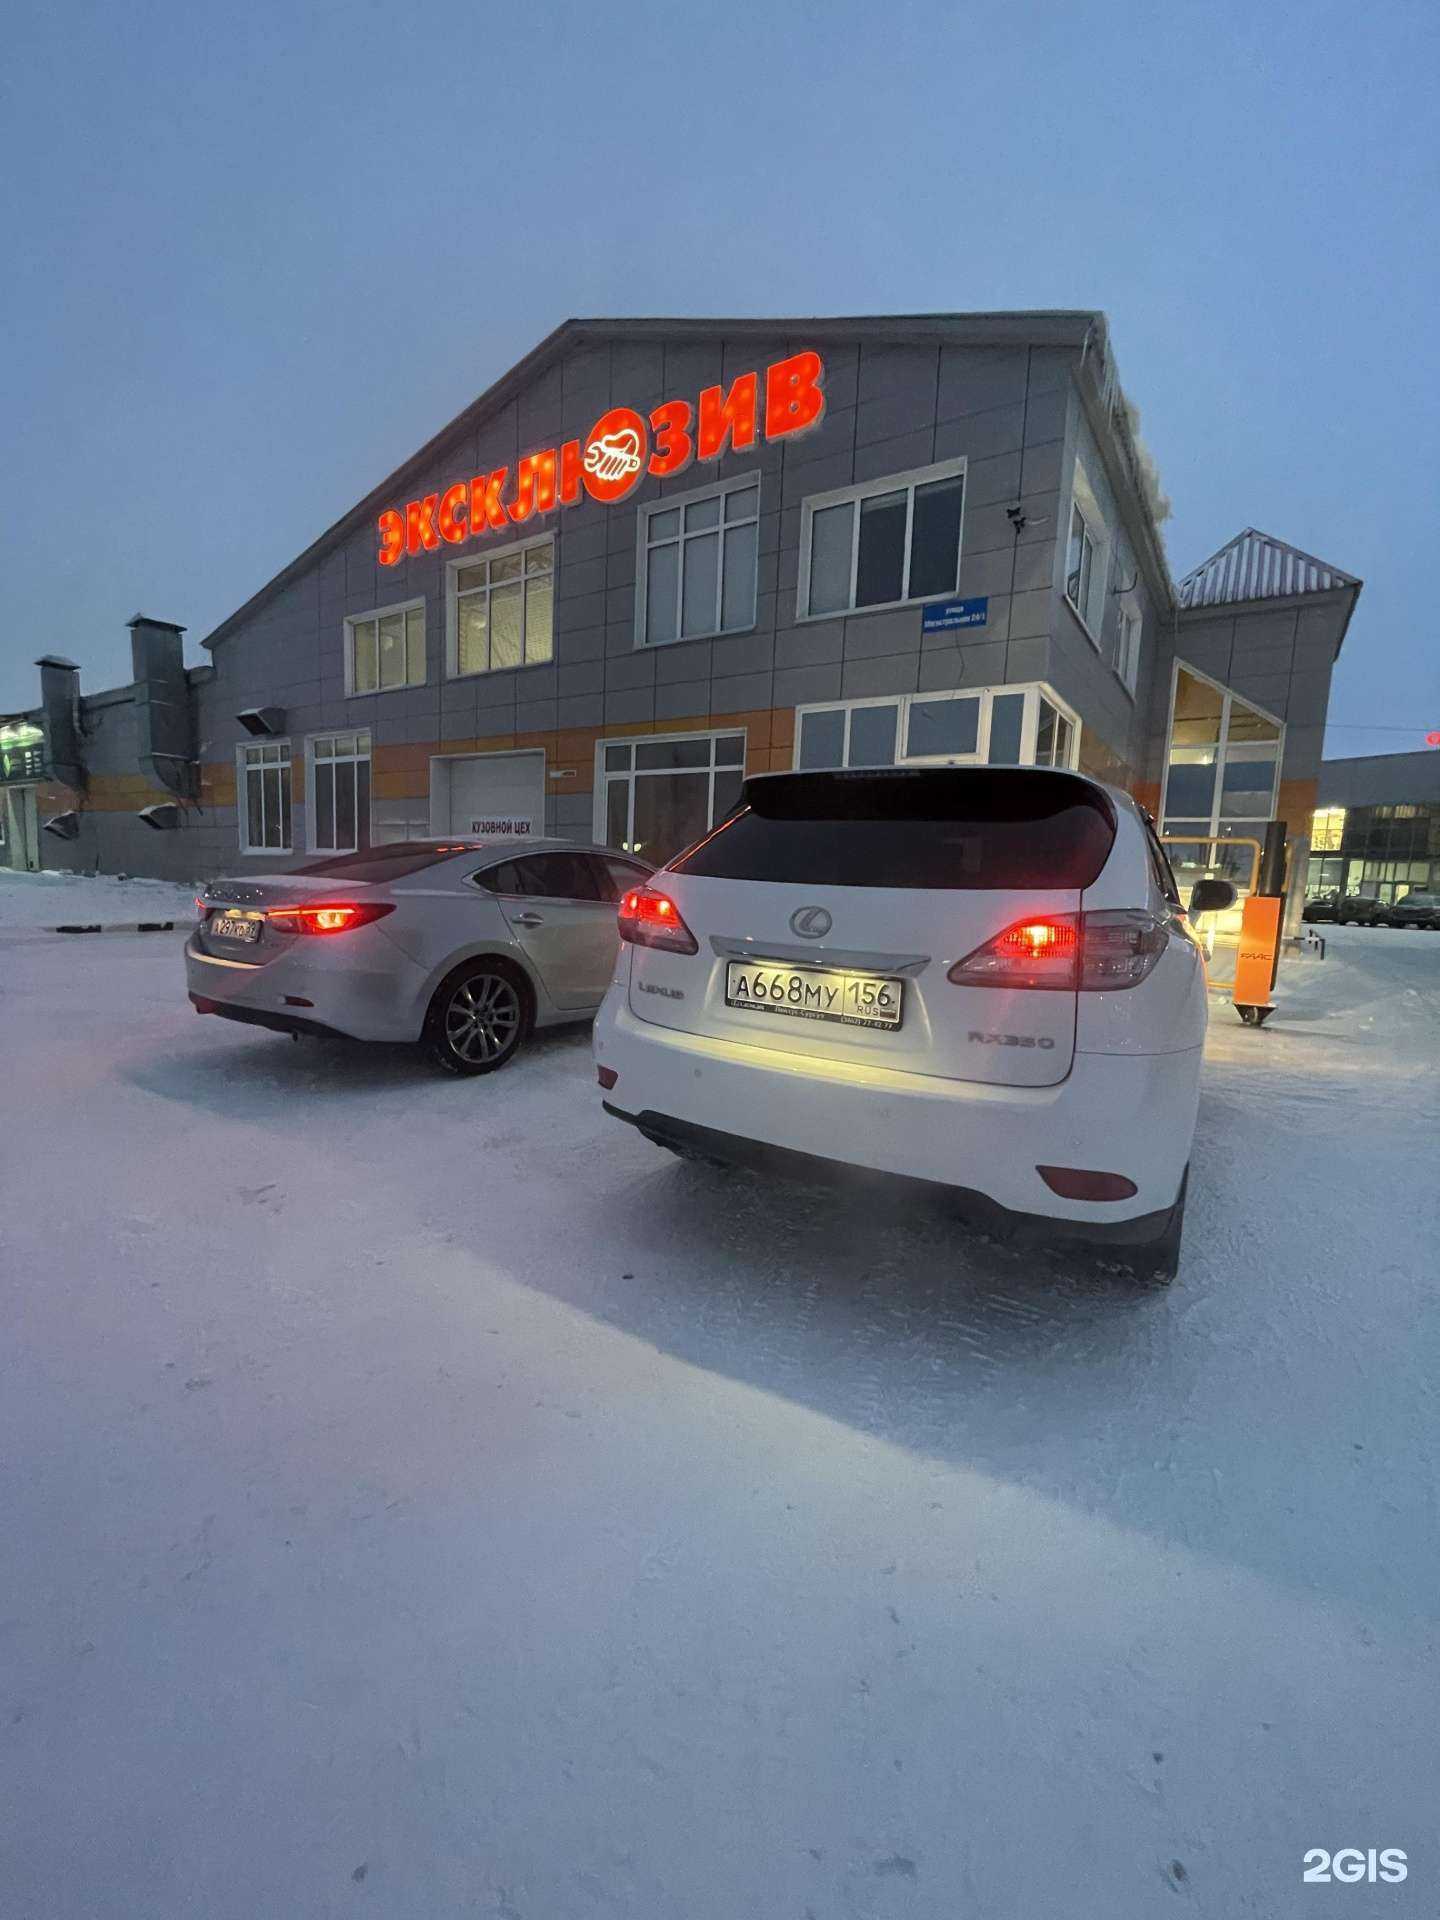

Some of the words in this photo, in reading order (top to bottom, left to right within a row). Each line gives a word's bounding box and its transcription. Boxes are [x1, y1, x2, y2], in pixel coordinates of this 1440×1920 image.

[378, 350, 826, 567] ЭКСКЛЮЗИВ
[472, 818, 513, 834] КУЗОВНОЙ
[514, 821, 531, 836] ЦЕХ
[638, 980, 685, 1000] LEXUS
[736, 971, 840, 1008] А668МУ
[847, 981, 891, 1007] 156
[856, 1005, 880, 1017] RUS
